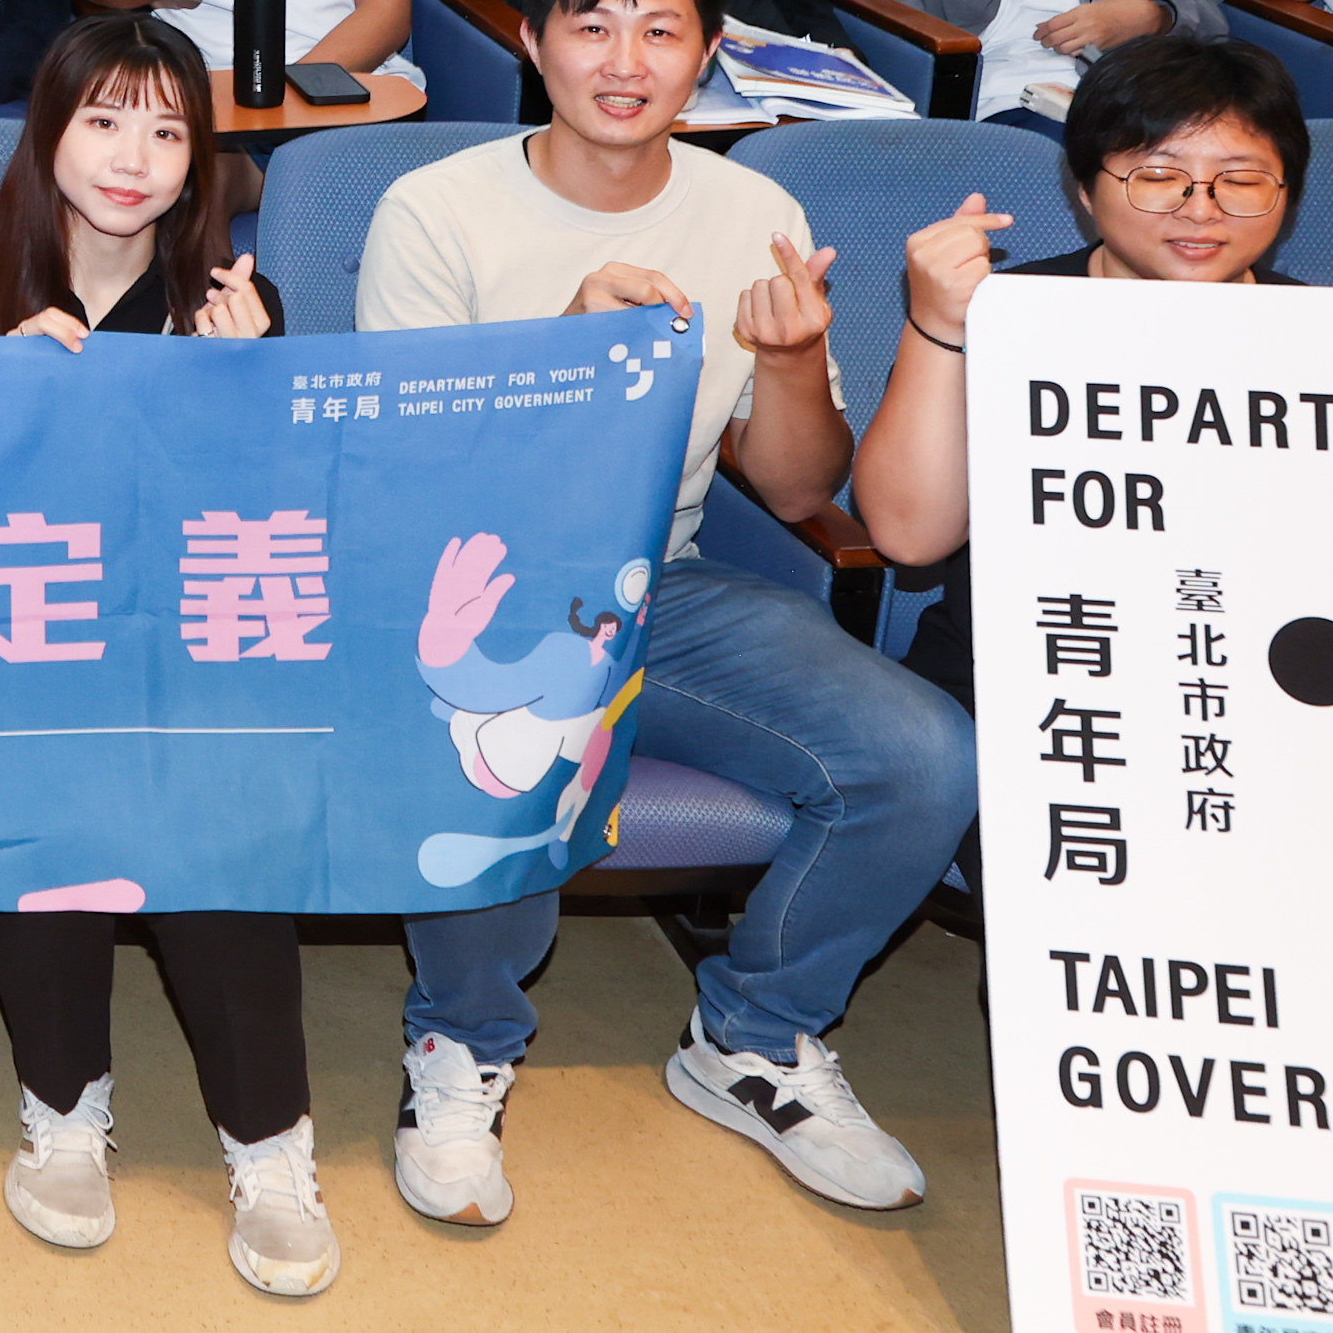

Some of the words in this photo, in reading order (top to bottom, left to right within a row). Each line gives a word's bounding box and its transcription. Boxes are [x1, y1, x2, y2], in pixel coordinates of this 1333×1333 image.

[290, 395, 381, 424] 青年局
[292, 371, 383, 390] 臺北市政府
[398, 400, 443, 416] TAIPEI
[452, 397, 485, 412] CITY
[494, 388, 594, 409] GOVERNMENT
[399, 375, 496, 394] DEPARTMENT
[508, 372, 536, 387] FOR
[549, 366, 596, 382] YOUTH
[1029, 379, 1333, 451] DEPART
[1031, 468, 1166, 532] FOR
[1175, 568, 1235, 833] 臺北市政府
[1036, 593, 1127, 886] 青年局
[1049, 949, 1280, 1029] TAIPEI
[1058, 1045, 1331, 1130] GOVER
